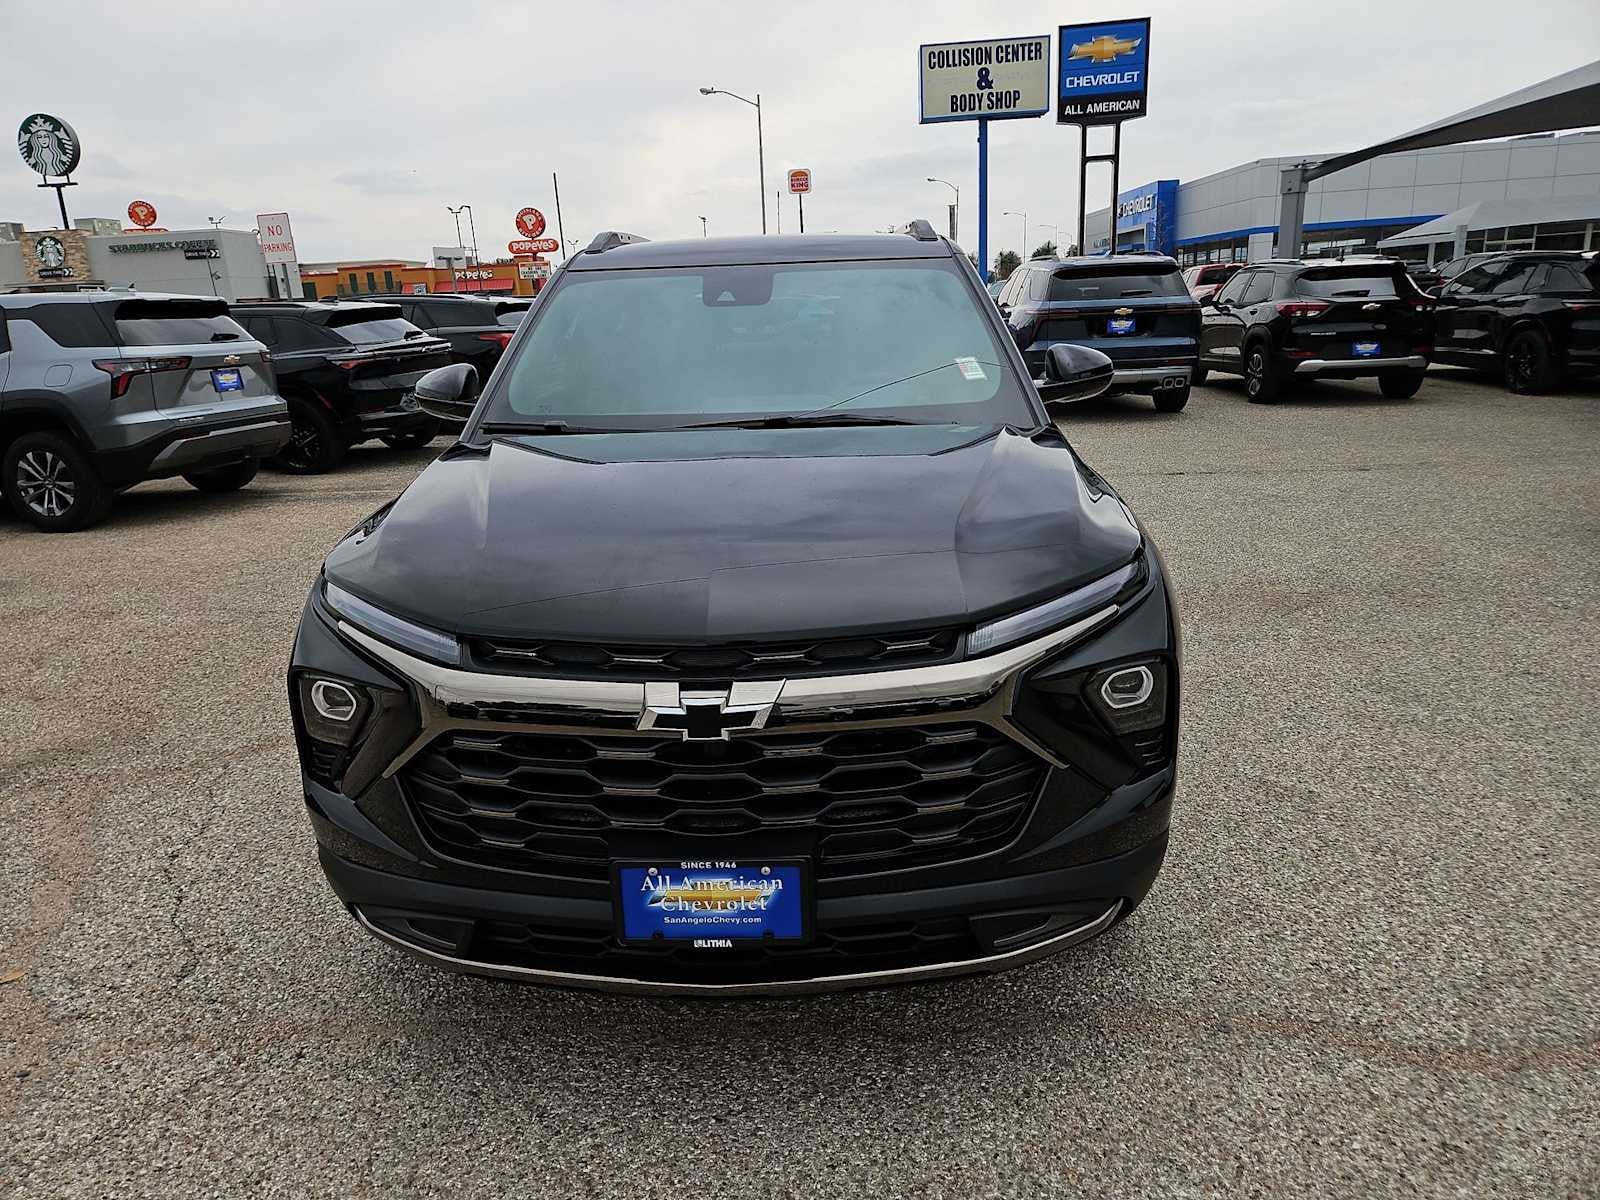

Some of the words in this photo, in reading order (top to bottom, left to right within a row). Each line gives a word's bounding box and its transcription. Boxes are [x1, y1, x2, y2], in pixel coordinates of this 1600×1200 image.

[928, 45, 993, 70] COLLISION
[995, 41, 1043, 64] CENTER
[976, 67, 993, 90] &
[1066, 70, 1141, 89] CHEVROLET
[950, 92, 986, 113] BODY
[986, 90, 1021, 111] SHOP
[1064, 104, 1084, 116] ALL
[1086, 99, 1141, 114] AMERICAN
[1122, 194, 1154, 217] CHEVROLET
[267, 224, 283, 237] NO
[263, 241, 294, 254] PARKING
[714, 861, 737, 869] 1946
[640, 875, 671, 892] All
[680, 876, 784, 892] American
[660, 895, 768, 912] Chevrolet
[664, 916, 762, 925] SanAngeloChevy.com
[702, 939, 733, 948] LITHIA
